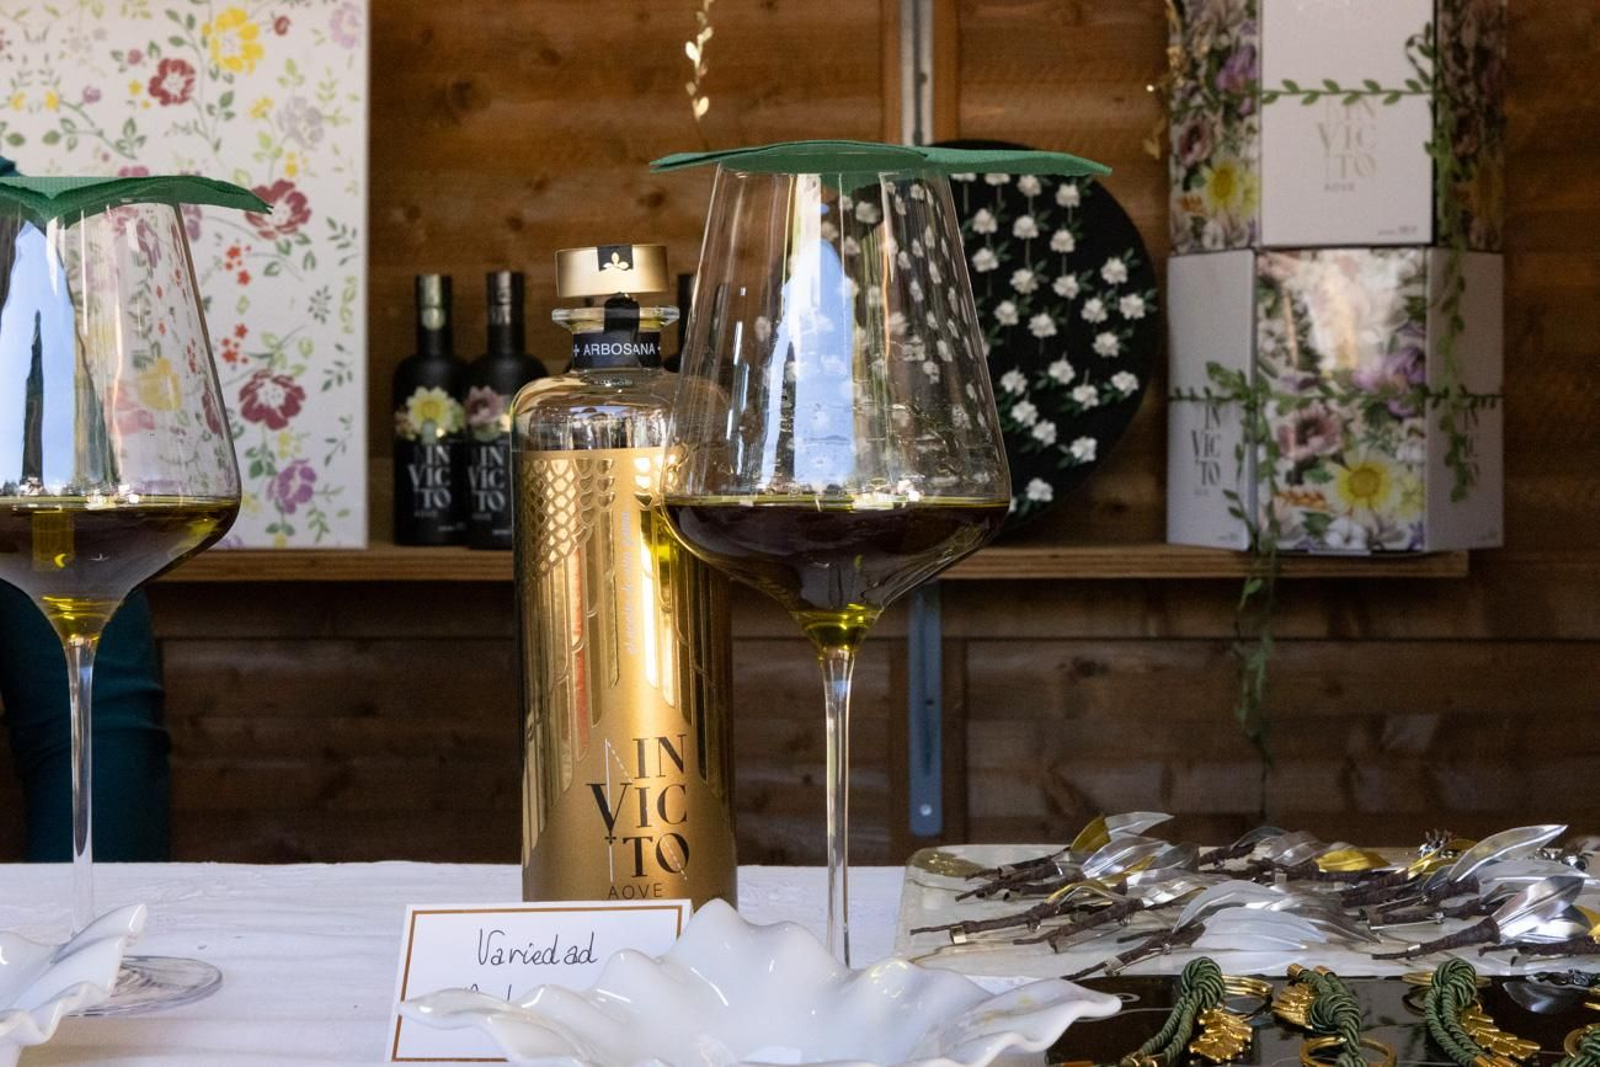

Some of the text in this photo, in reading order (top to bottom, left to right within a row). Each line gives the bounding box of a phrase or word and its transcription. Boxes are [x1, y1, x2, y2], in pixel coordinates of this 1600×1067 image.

[582, 342, 656, 356] ARBOSANA
[426, 444, 451, 466] IN
[479, 445, 505, 467] IN
[407, 463, 451, 491] VIC
[467, 465, 506, 492] VIC
[420, 487, 452, 510] TO
[473, 489, 506, 513] TO
[632, 734, 687, 779] IN
[586, 783, 688, 834] VIC
[622, 832, 690, 878] TO
[607, 882, 664, 900] AOVE
[477, 928, 599, 966] Variedad
